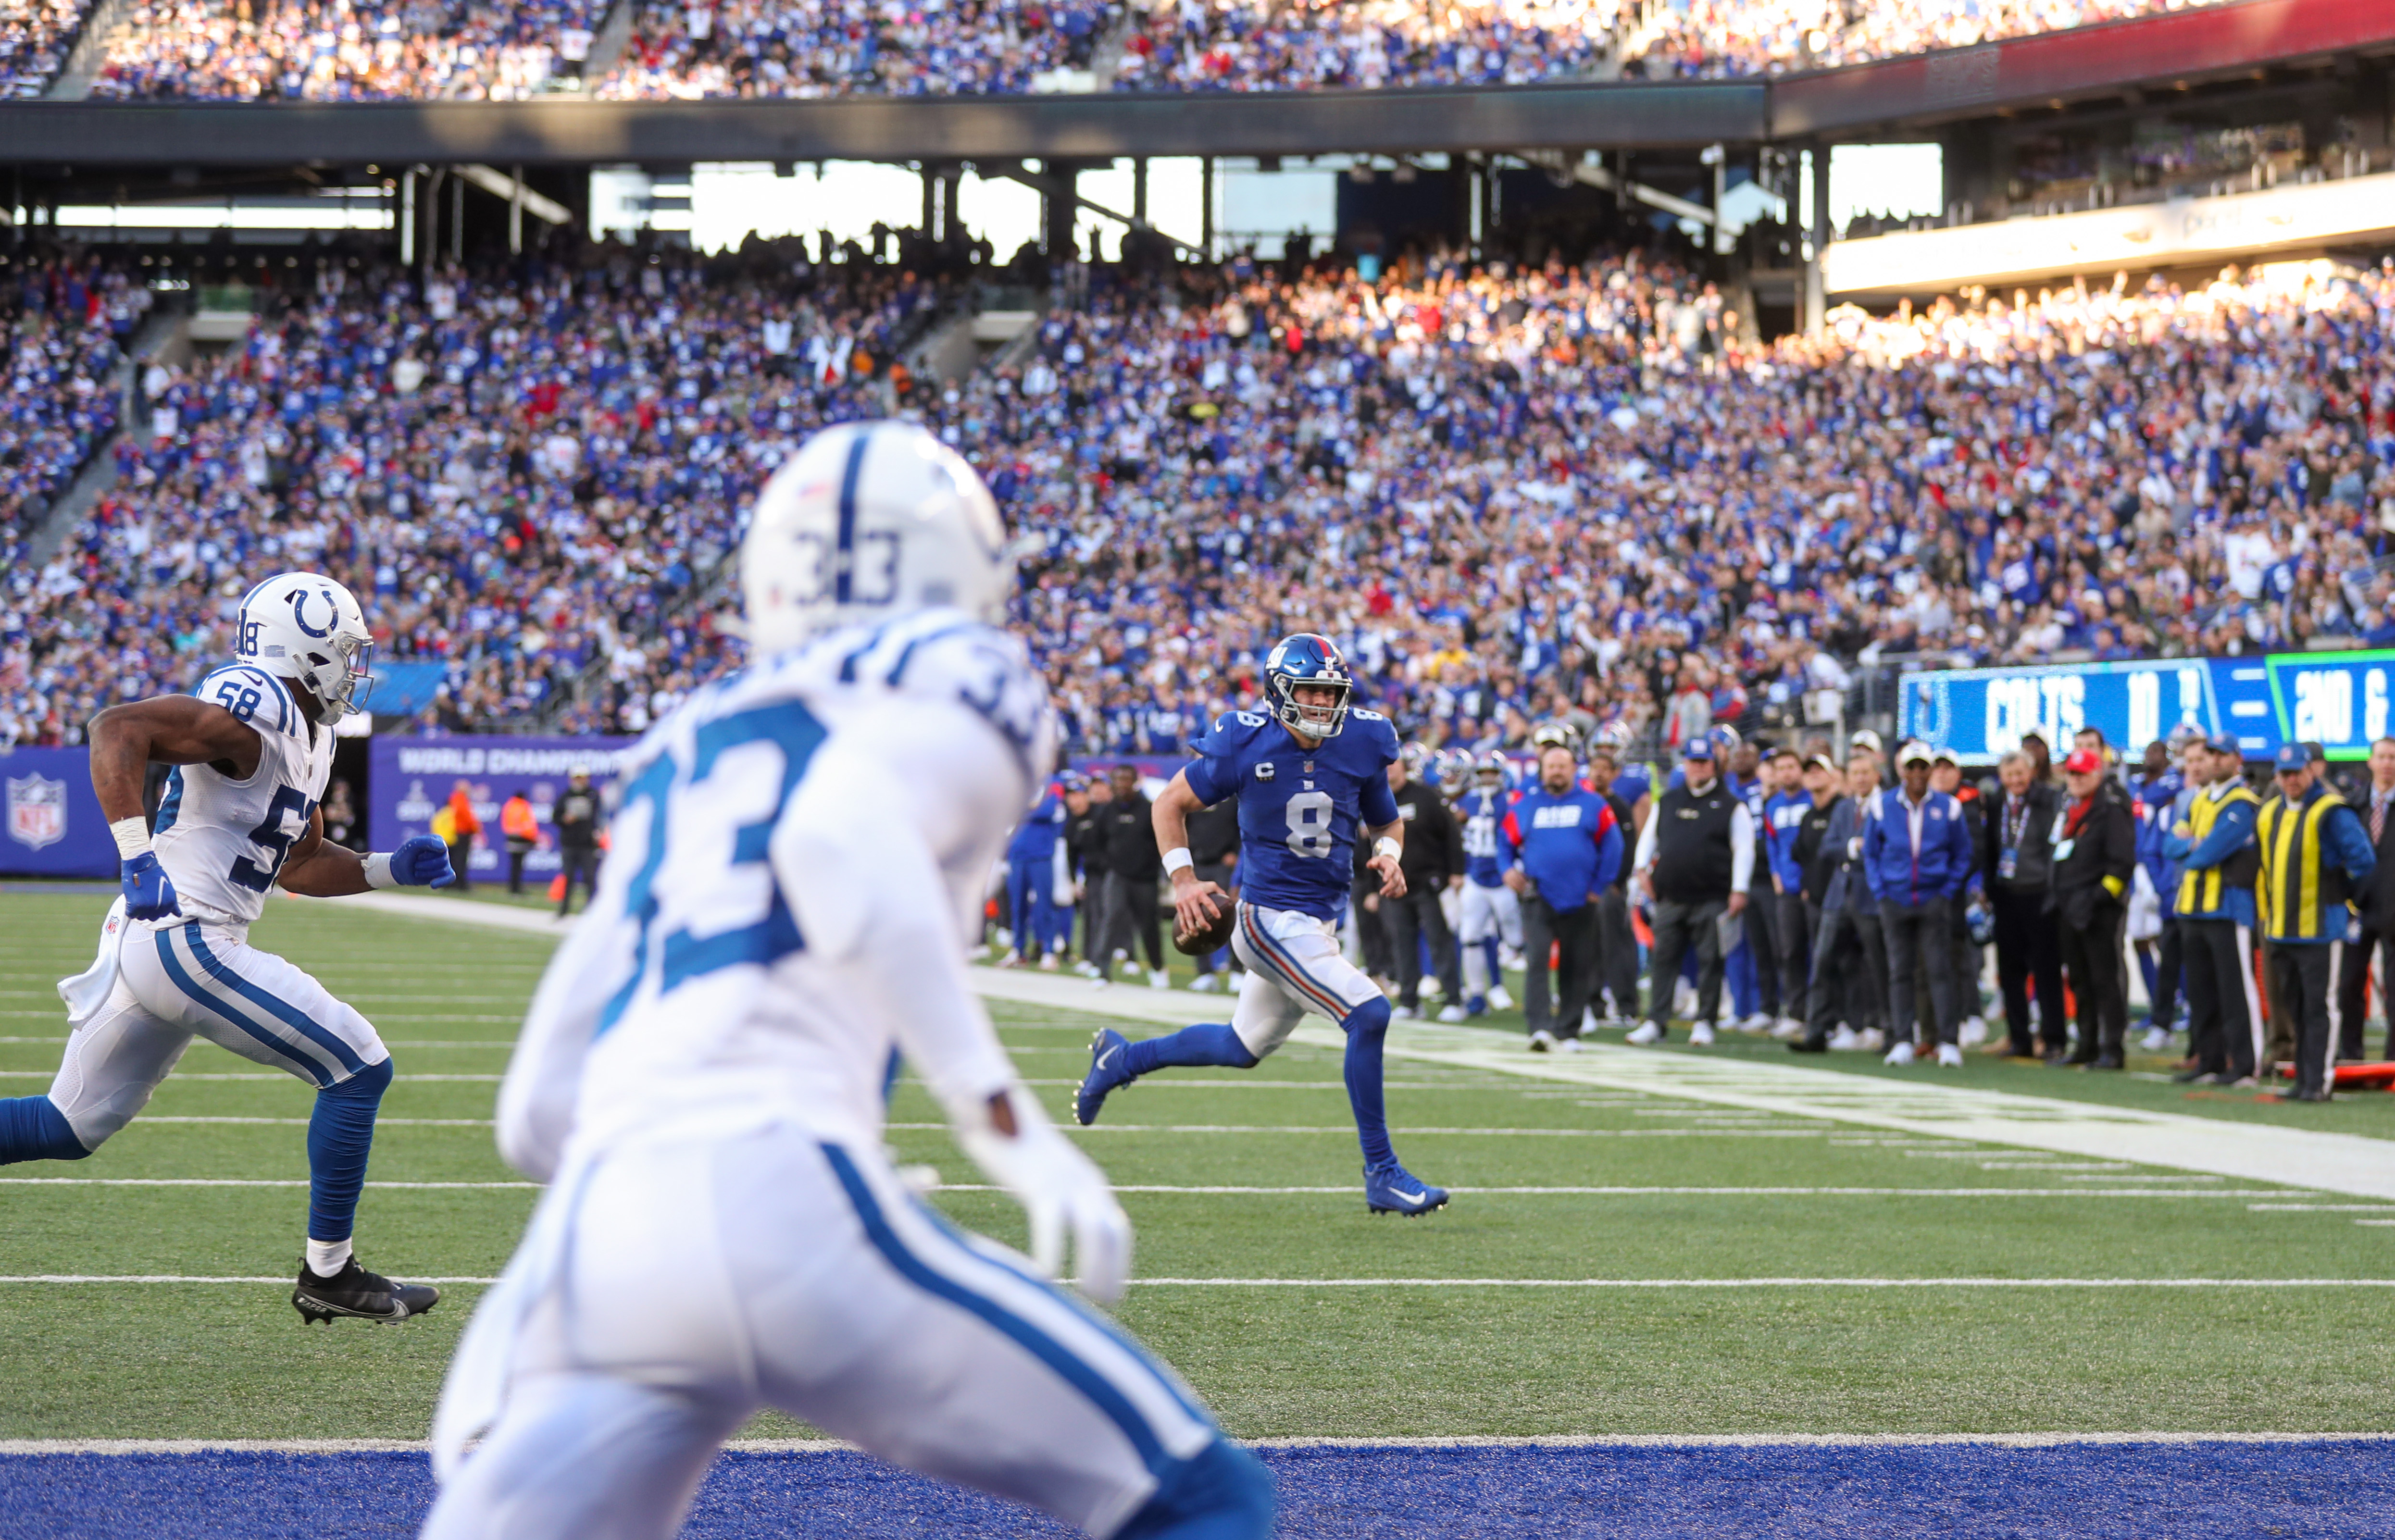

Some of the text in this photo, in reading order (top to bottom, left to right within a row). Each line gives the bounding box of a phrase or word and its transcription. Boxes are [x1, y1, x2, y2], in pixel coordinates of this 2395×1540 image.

[1324, 656, 1334, 671] 8
[216, 681, 262, 722] 58
[1236, 710, 1267, 728] 8
[1353, 707, 1384, 721] 8
[1985, 674, 2085, 754] COLTS
[2295, 670, 2352, 744] 2ND
[398, 747, 621, 776] WORLD CHAMPION
[1255, 761, 1275, 778] C
[227, 783, 319, 894] 5
[1285, 791, 1334, 859] 8
